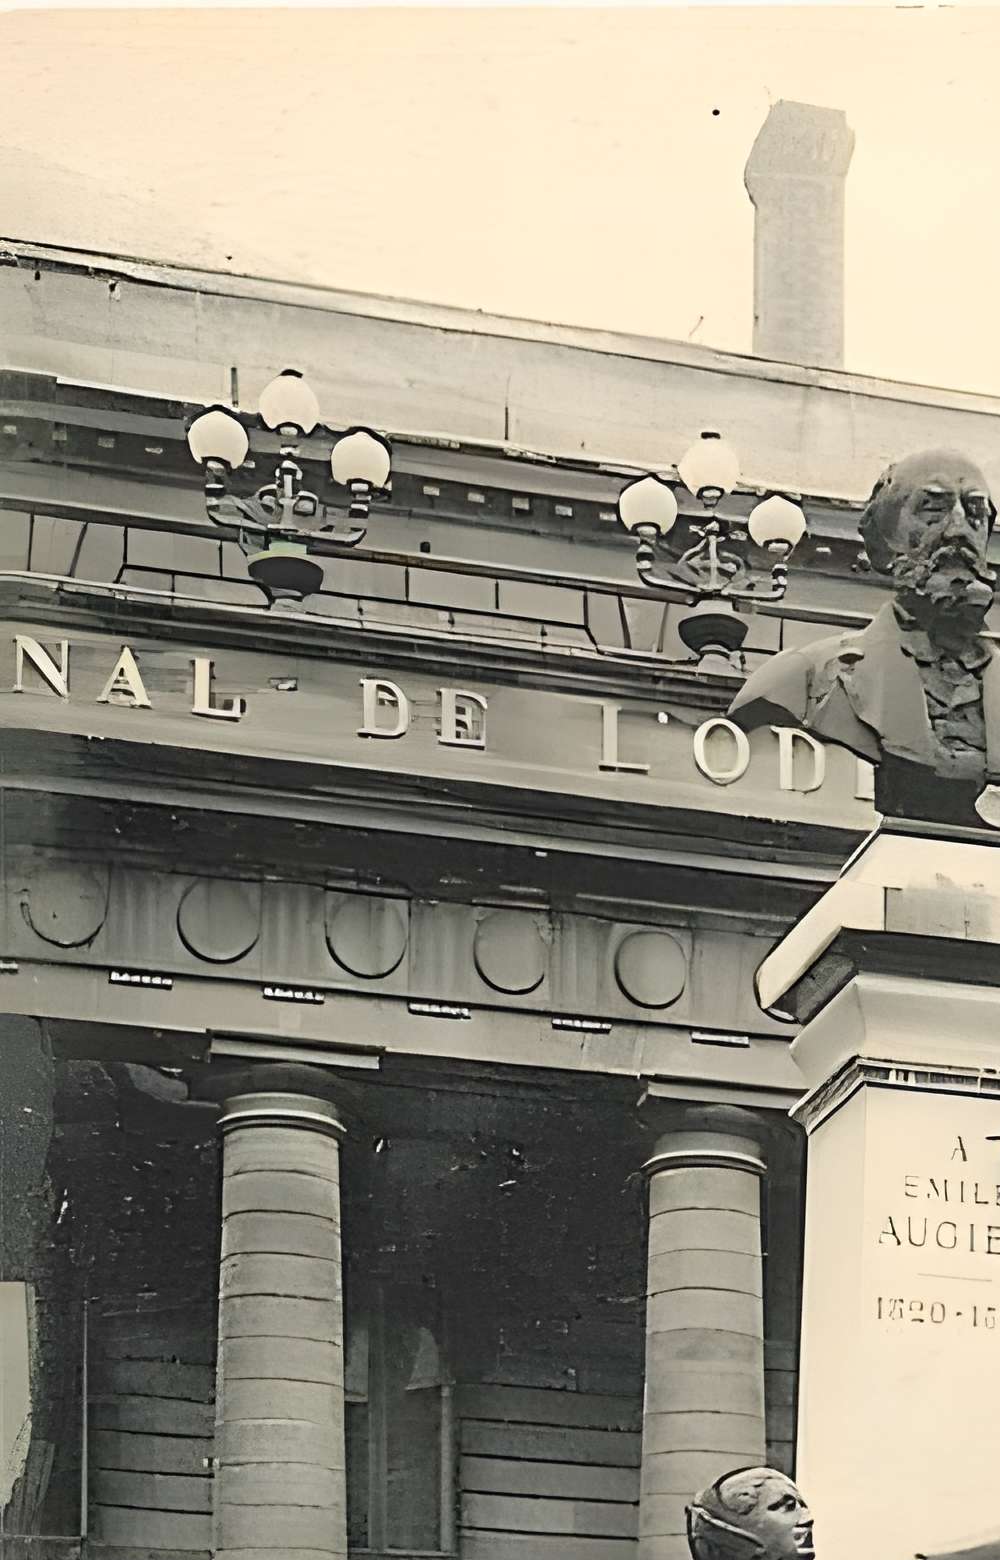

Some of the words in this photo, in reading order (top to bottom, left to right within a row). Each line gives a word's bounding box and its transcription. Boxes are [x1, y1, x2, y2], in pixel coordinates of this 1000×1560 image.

[12, 634, 246, 722] NAL
[355, 676, 488, 751] DE
[950, 1135, 968, 1162] A
